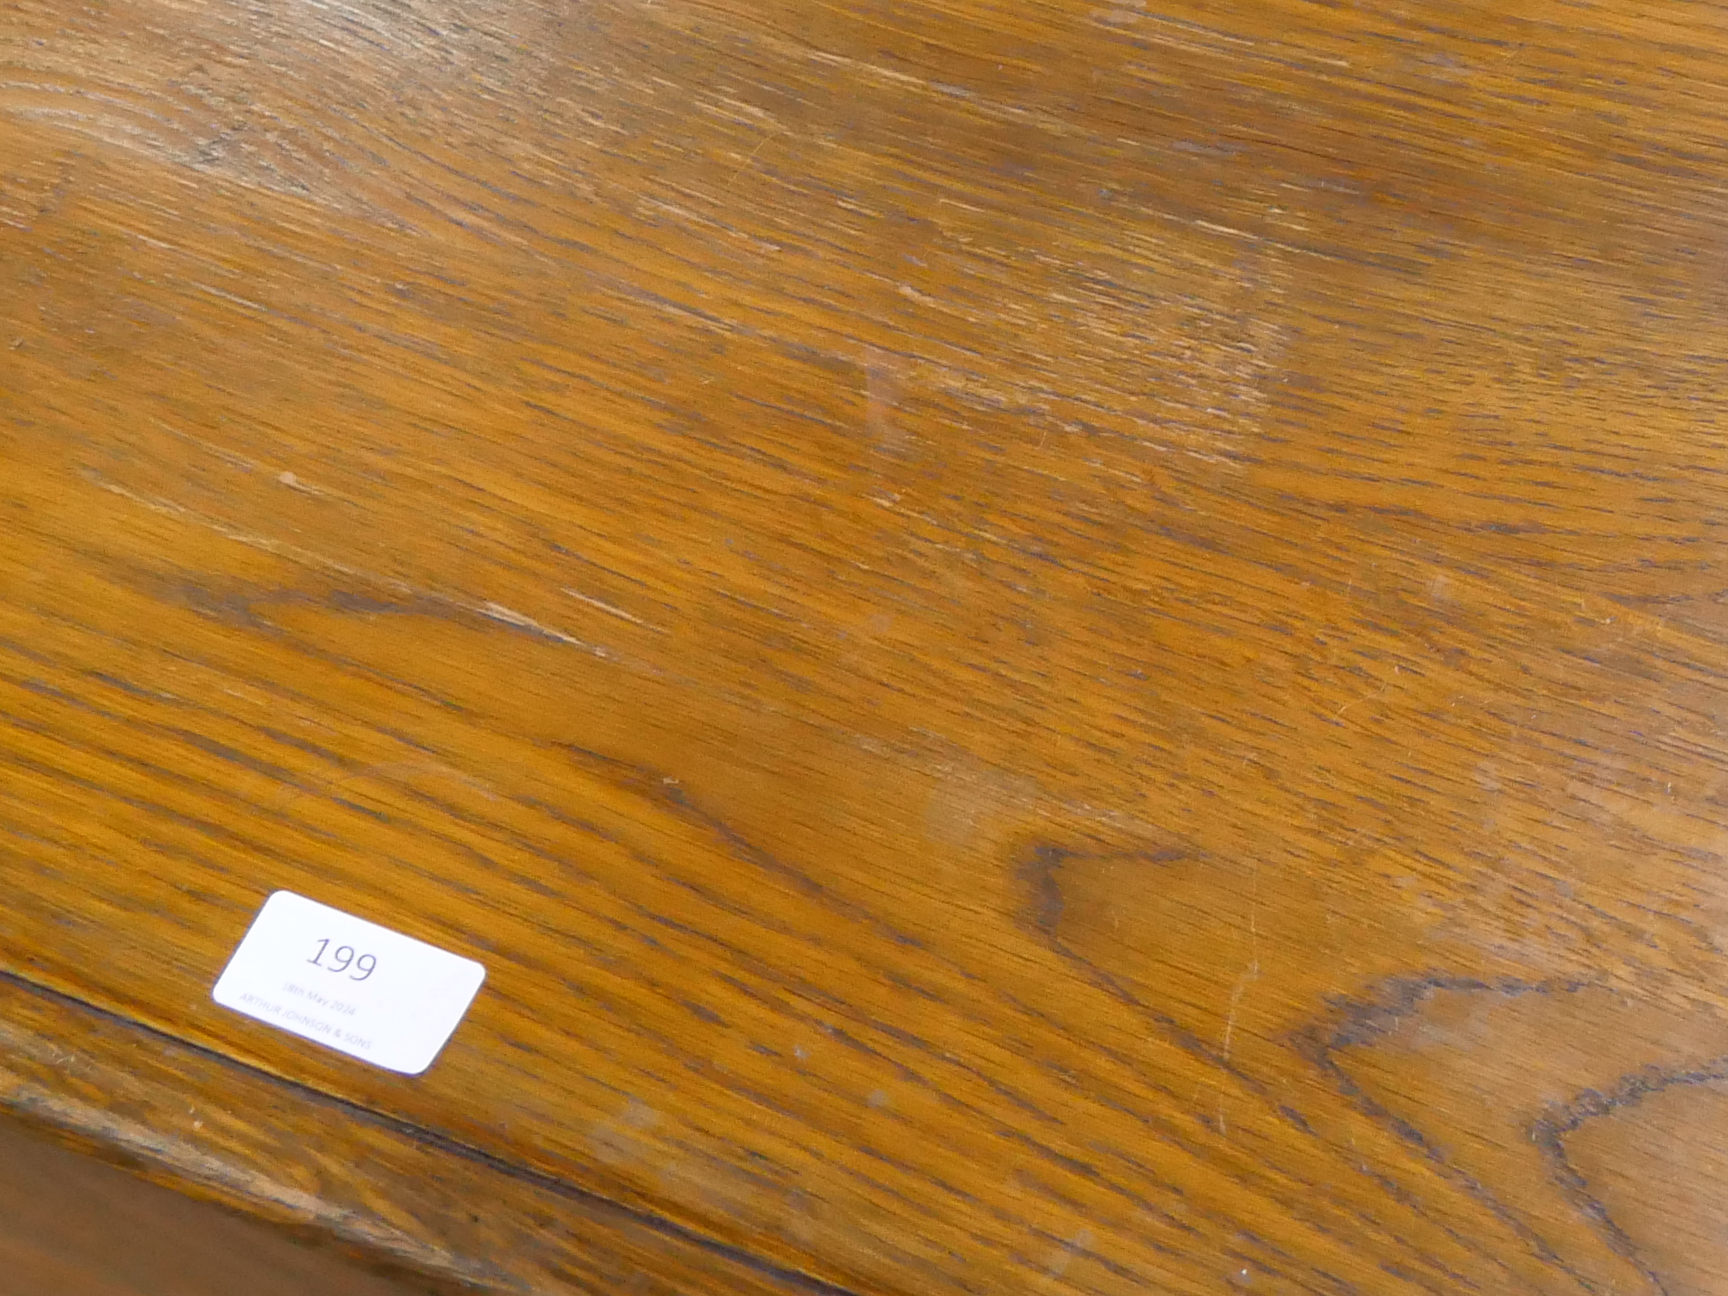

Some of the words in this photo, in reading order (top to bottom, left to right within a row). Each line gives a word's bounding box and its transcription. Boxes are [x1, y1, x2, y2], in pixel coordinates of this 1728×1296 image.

[306, 937, 378, 982] 199
[239, 992, 283, 1014] ARTHUR
[282, 1010, 332, 1035] JOHNSON
[333, 1028, 343, 1039] &
[345, 1032, 373, 1051] SONS
[307, 991, 329, 1007] May
[330, 1001, 358, 1017] 2024
